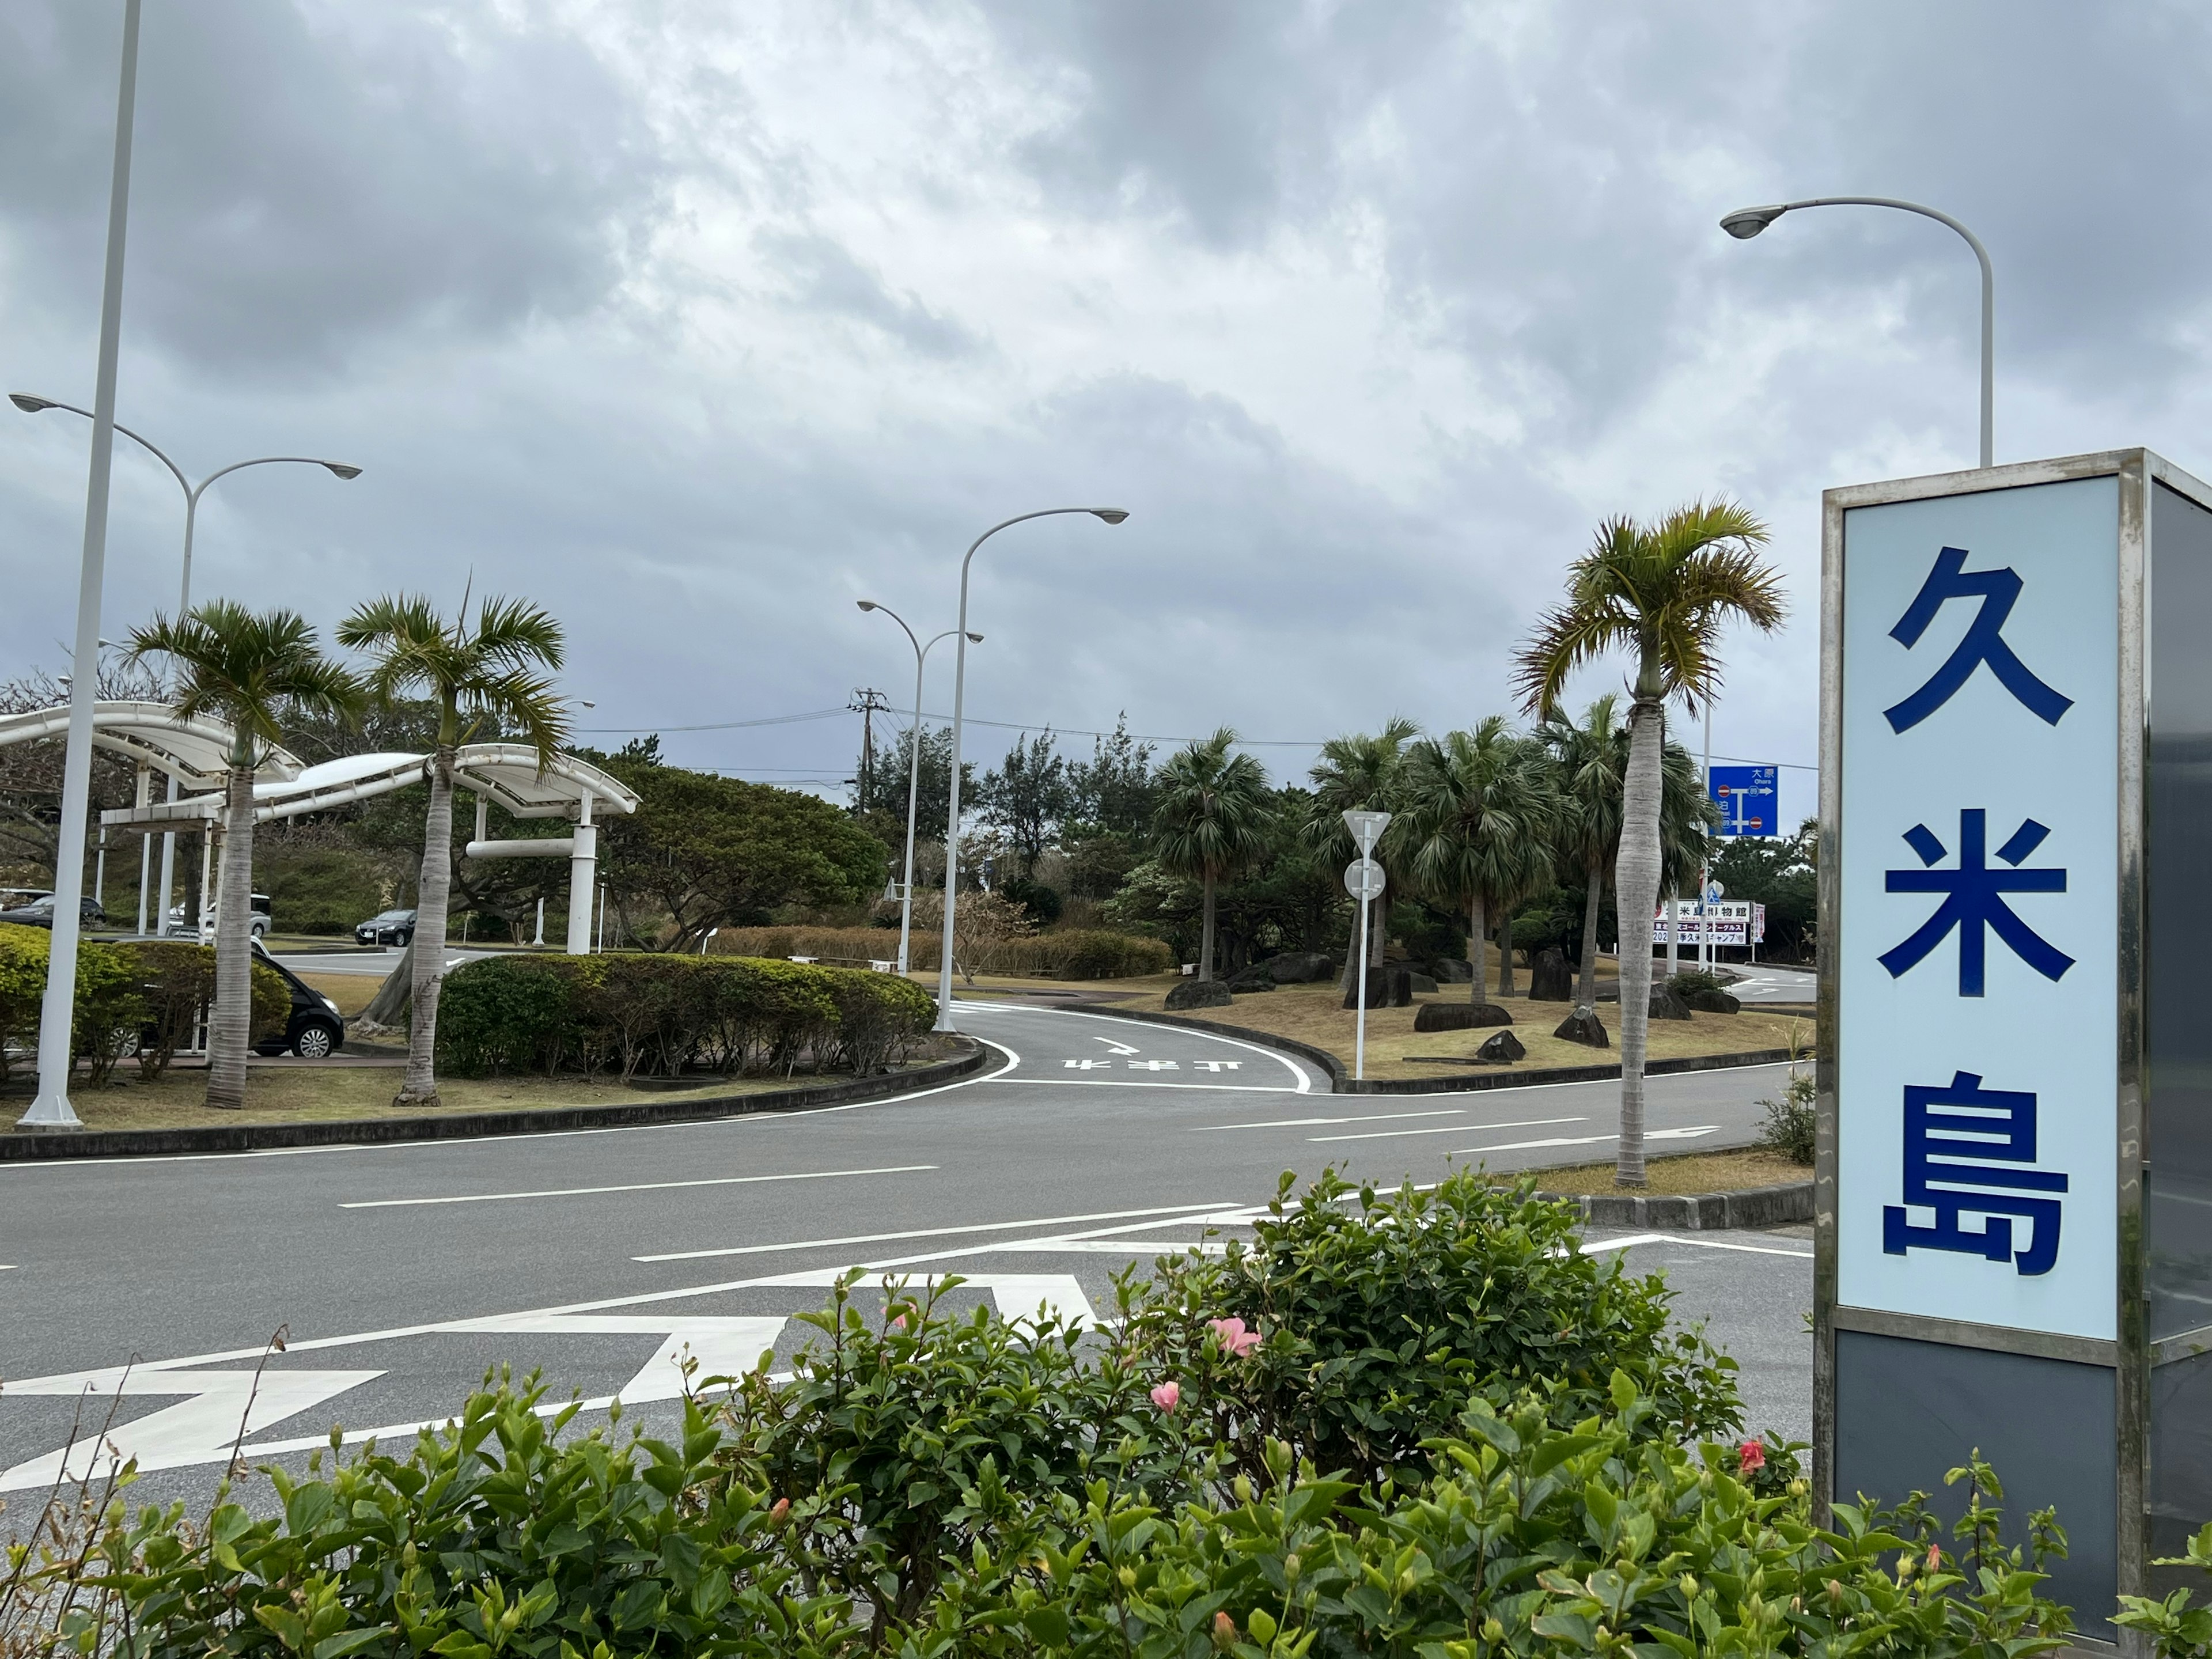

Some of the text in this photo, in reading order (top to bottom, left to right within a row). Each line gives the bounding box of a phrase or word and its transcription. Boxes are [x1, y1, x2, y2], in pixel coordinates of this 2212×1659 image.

[1752, 768, 1774, 778] 大原
[1718, 800, 1729, 810] 泊
[1877, 546, 2077, 1277] 久米島
[1061, 1059, 1244, 1073] 止まれ
